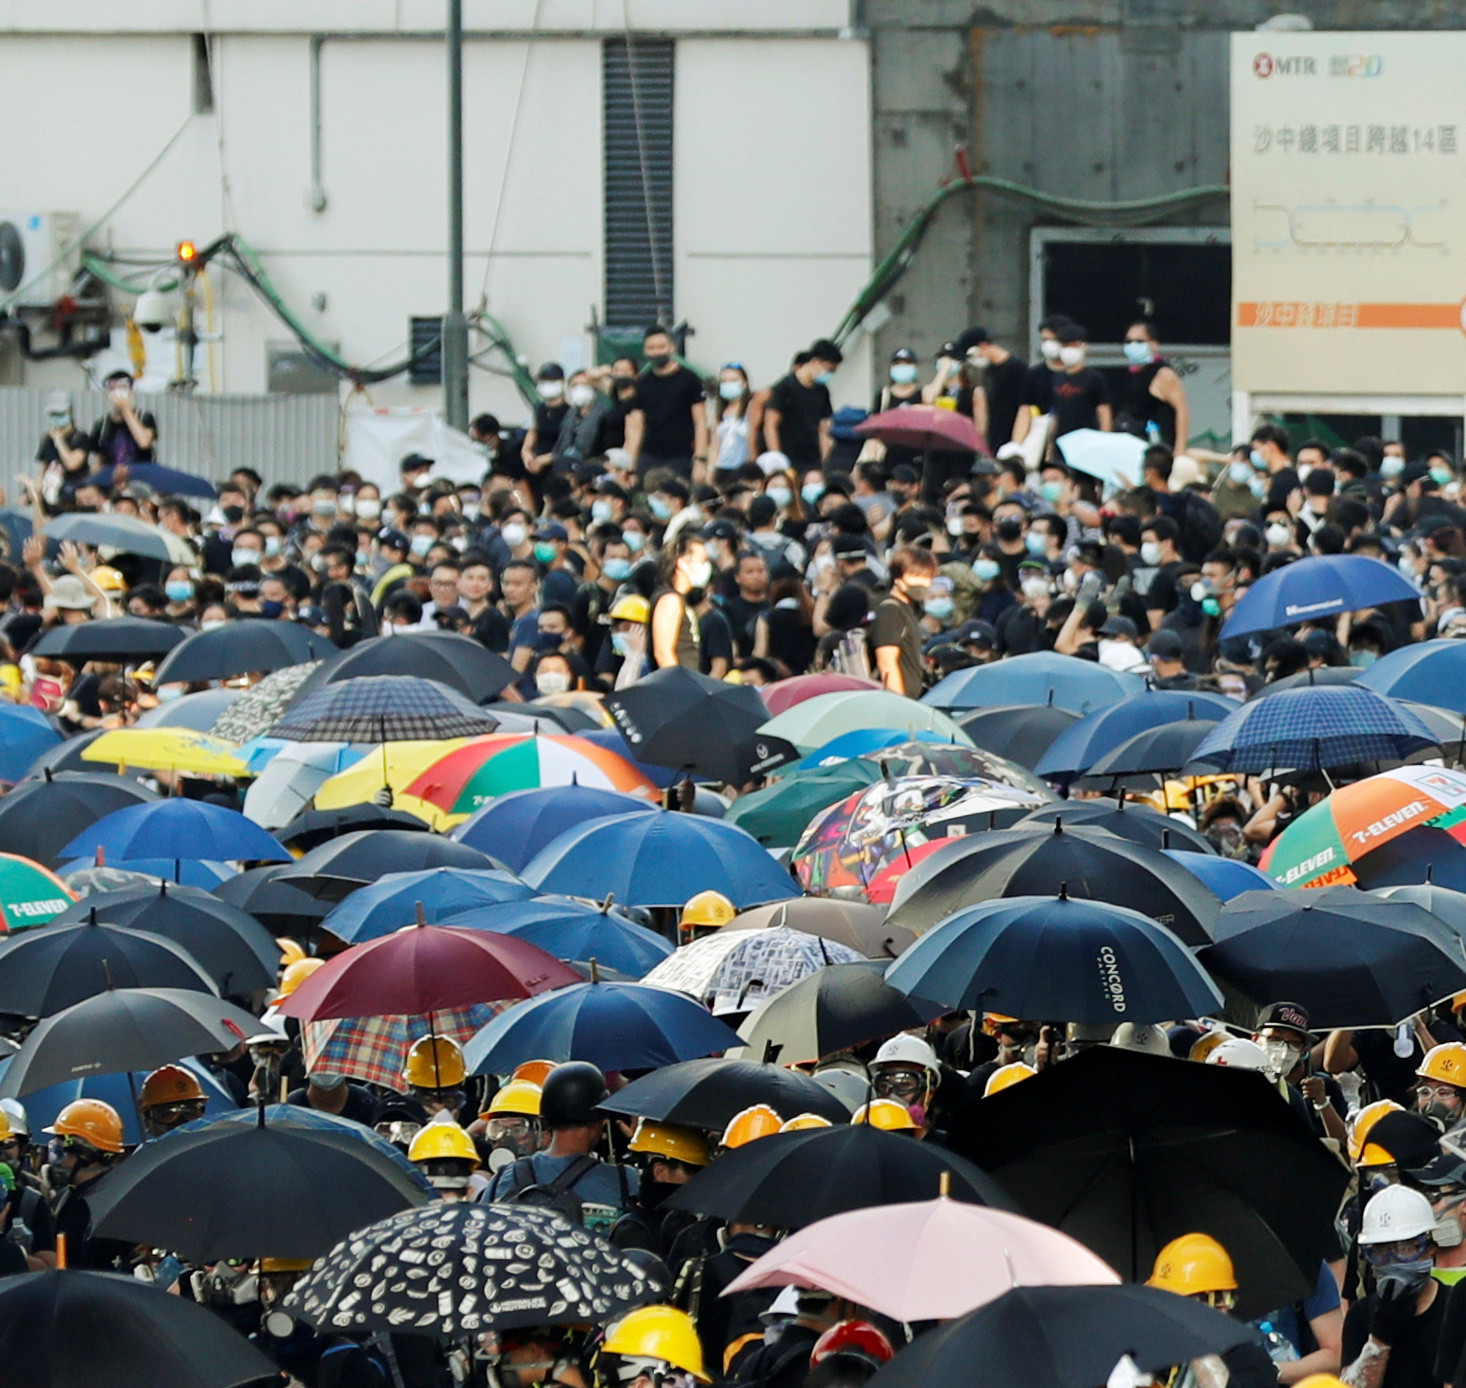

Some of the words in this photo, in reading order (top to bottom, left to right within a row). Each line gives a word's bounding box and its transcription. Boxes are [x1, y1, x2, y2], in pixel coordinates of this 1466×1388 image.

[1275, 56, 1316, 75] MTR
[1352, 801, 1426, 844] 7-ELEVEN
[8, 898, 68, 918] 7-ELEVEN
